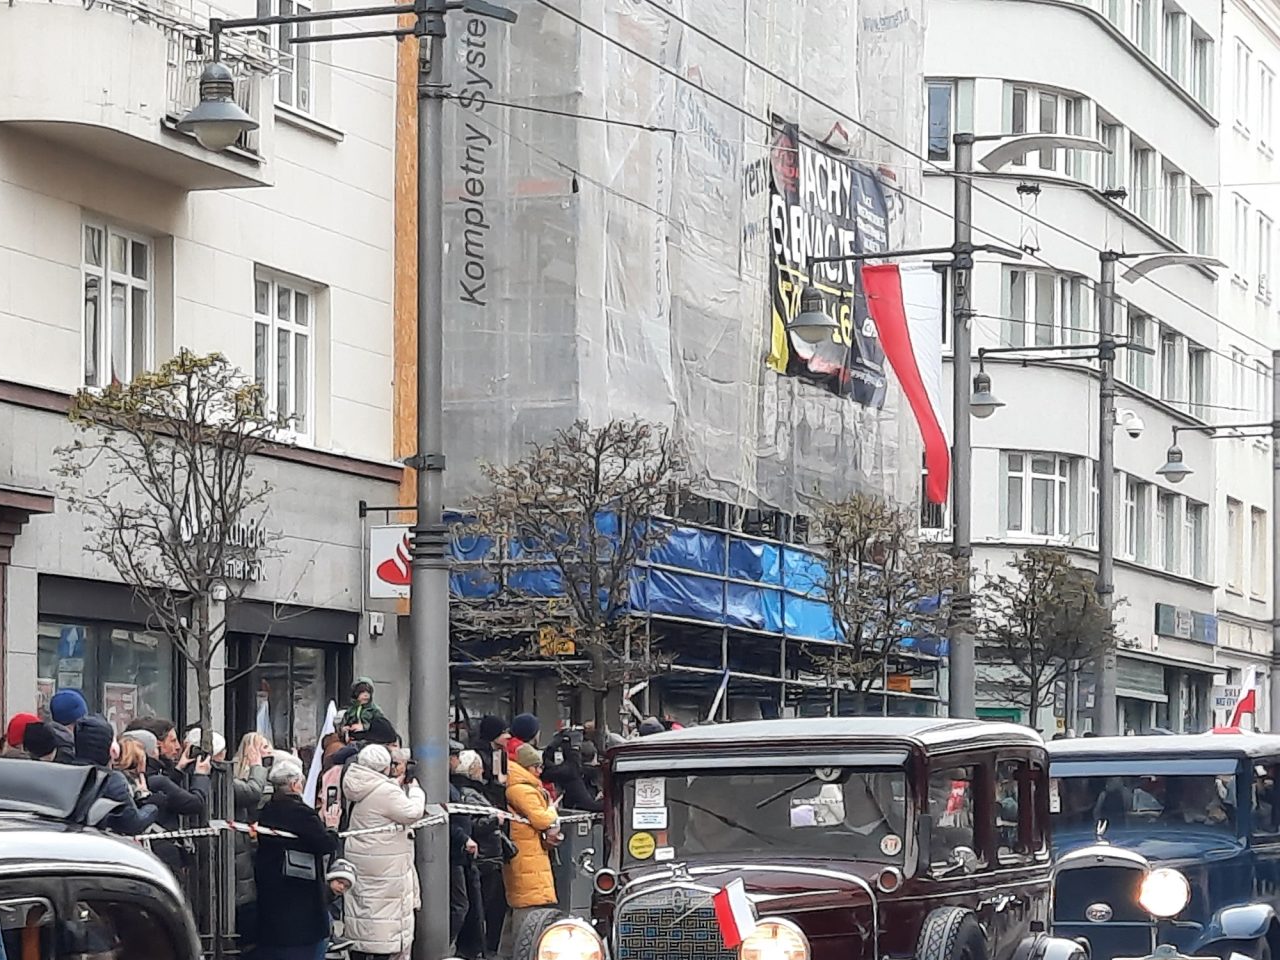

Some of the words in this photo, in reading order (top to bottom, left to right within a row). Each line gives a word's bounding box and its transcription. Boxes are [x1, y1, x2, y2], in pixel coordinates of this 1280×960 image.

[458, 18, 493, 113] Syste
[458, 122, 492, 307] Kompletny
[798, 144, 852, 220] ACHY
